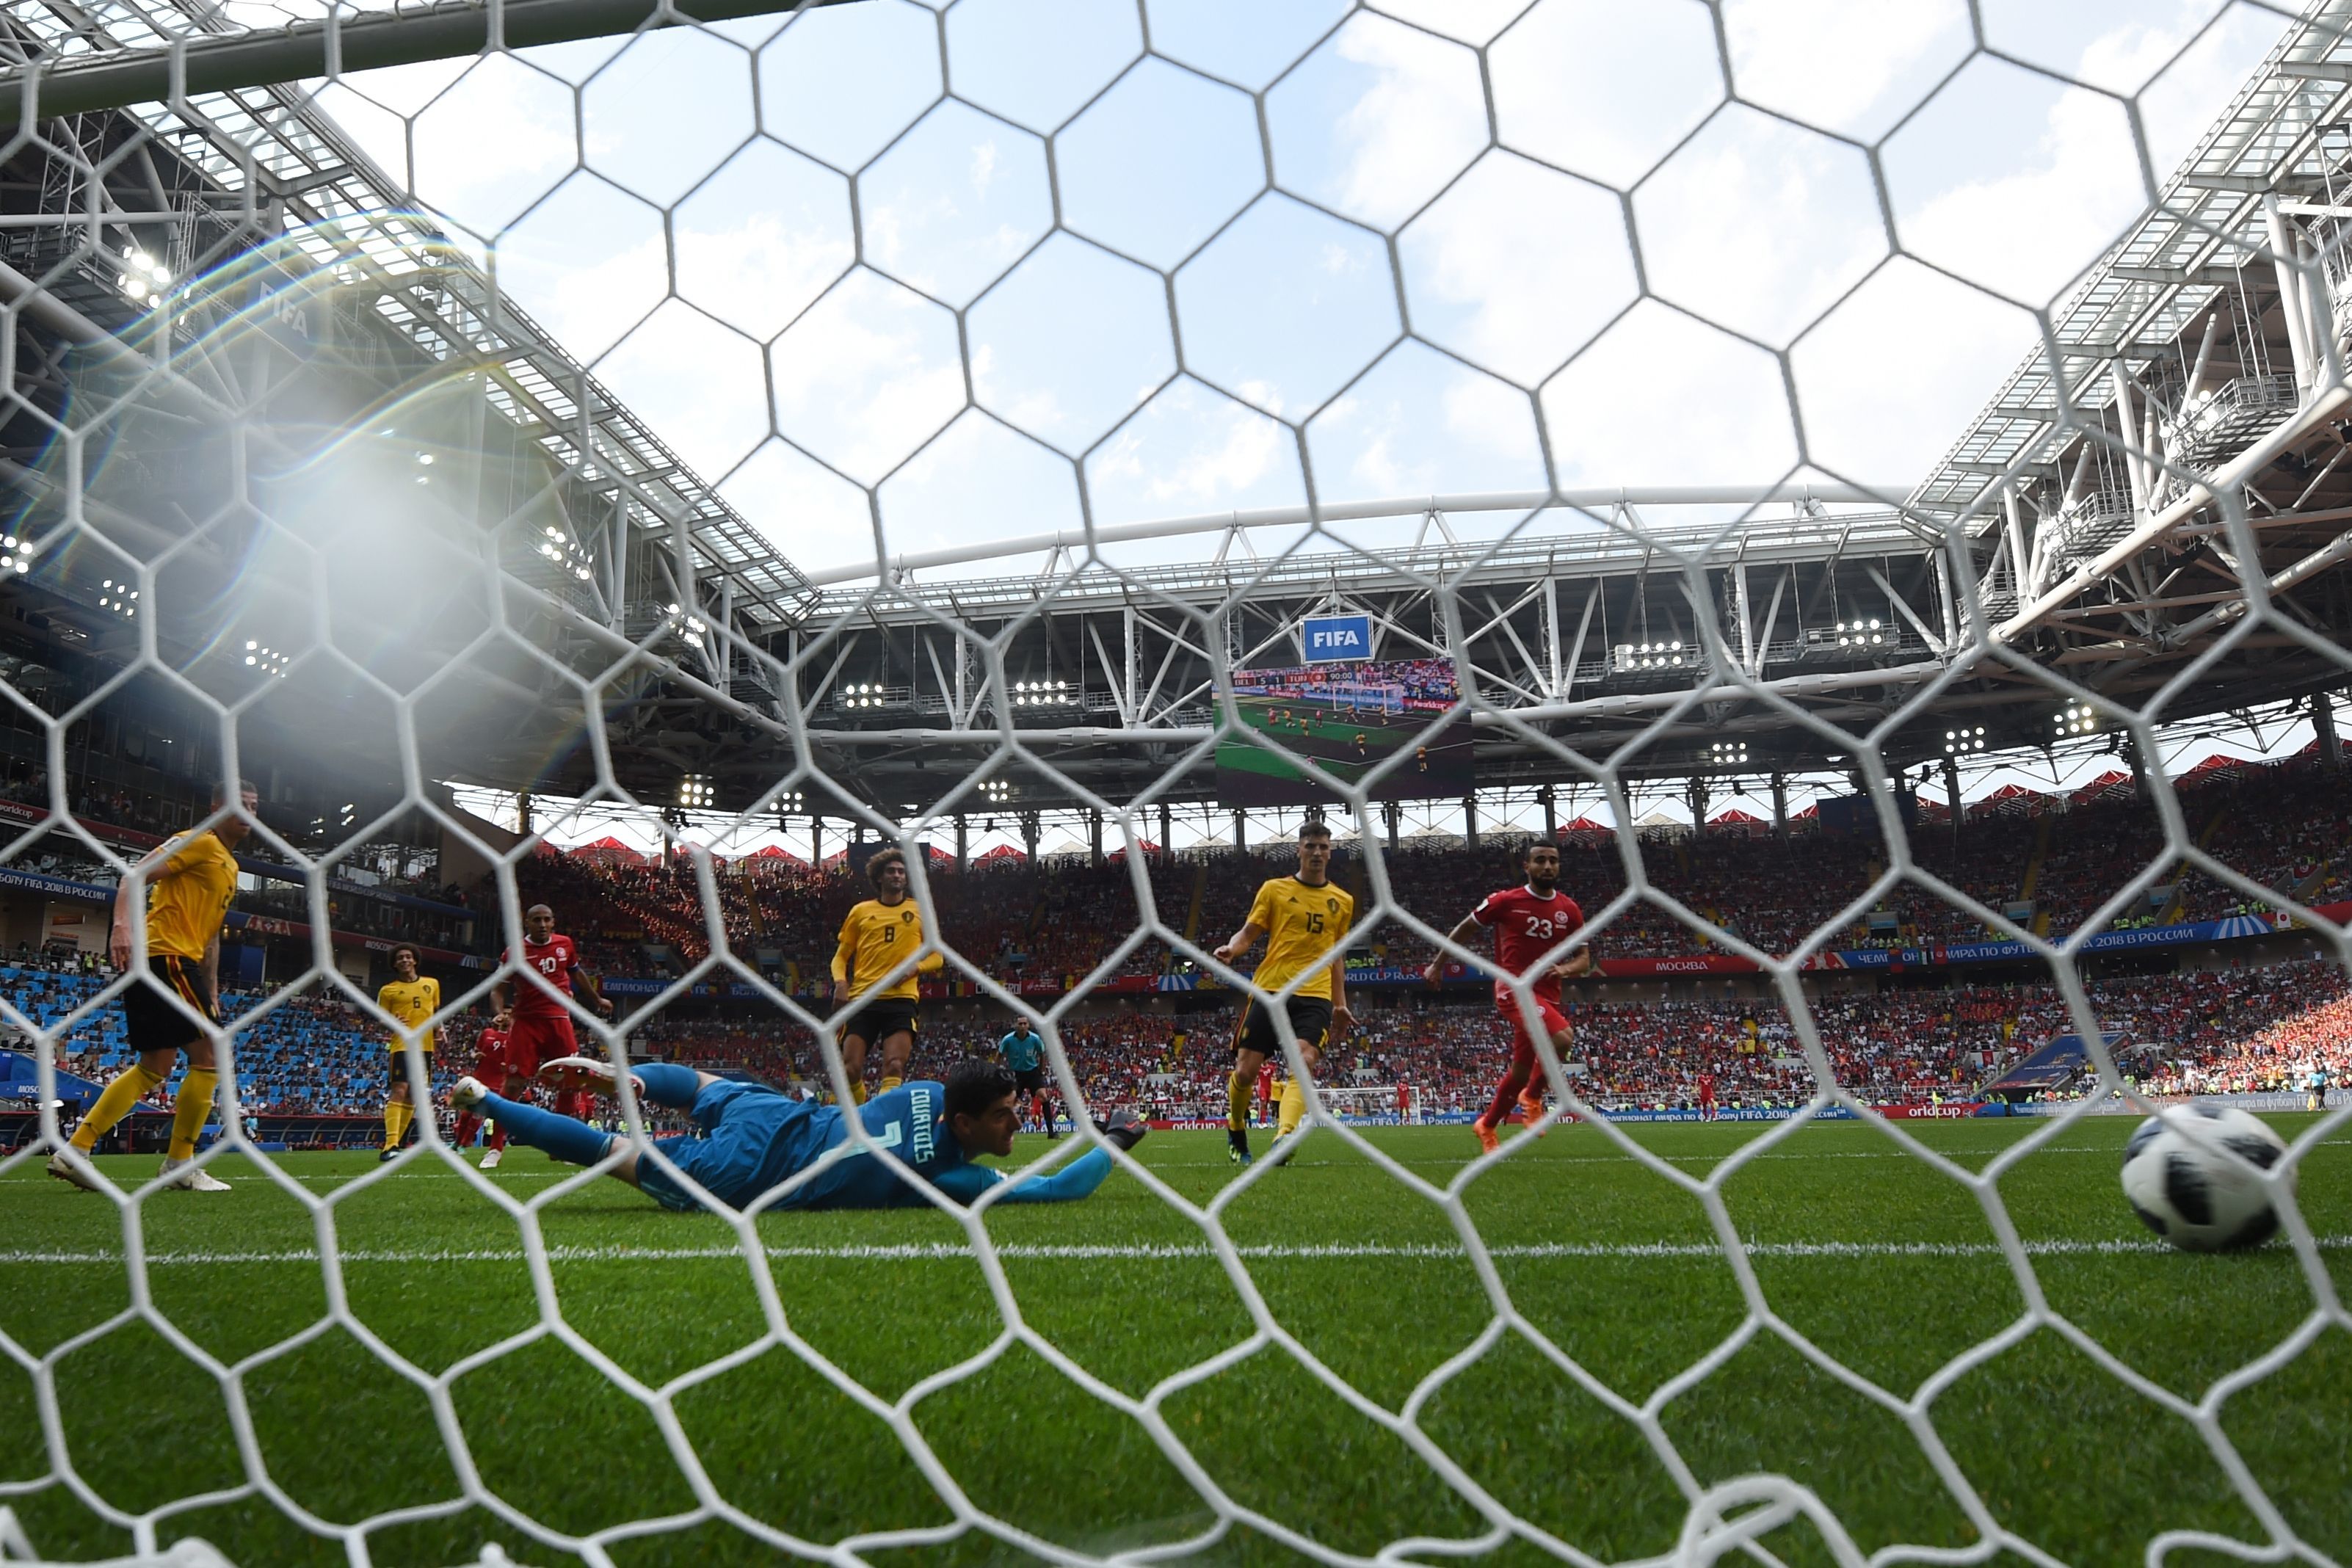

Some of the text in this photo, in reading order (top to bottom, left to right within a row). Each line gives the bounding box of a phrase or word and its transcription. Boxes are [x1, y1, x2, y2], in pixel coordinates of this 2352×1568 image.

[260, 281, 308, 338] FIFA
[1313, 630, 1360, 647] FIFA
[1235, 672, 1353, 686] BEL 5 1 TUN 90:00
[24, 878, 43, 890] FIFA
[44, 882, 64, 893] 2018
[65, 885, 71, 894] В
[72, 887, 107, 901] РОССИИ
[1306, 912, 1324, 934] 15
[1525, 916, 1553, 939] 23
[885, 926, 895, 943] 8
[1979, 947, 1998, 957] ПО
[2096, 935, 2124, 947] 2018
[2127, 934, 2136, 944] В
[2138, 929, 2193, 943] РОССИИ
[538, 957, 556, 974] 10
[1655, 961, 1708, 971] МОСКВА
[413, 996, 421, 1009] 6
[493, 1040, 501, 1051] 9
[1373, 1117, 1393, 1126] FIFA
[1655, 1114, 1682, 1122] мира
[1741, 1110, 1763, 1119] FIFA
[1765, 1109, 1790, 1119] 2018
[910, 1089, 934, 1164] COURTOIS
